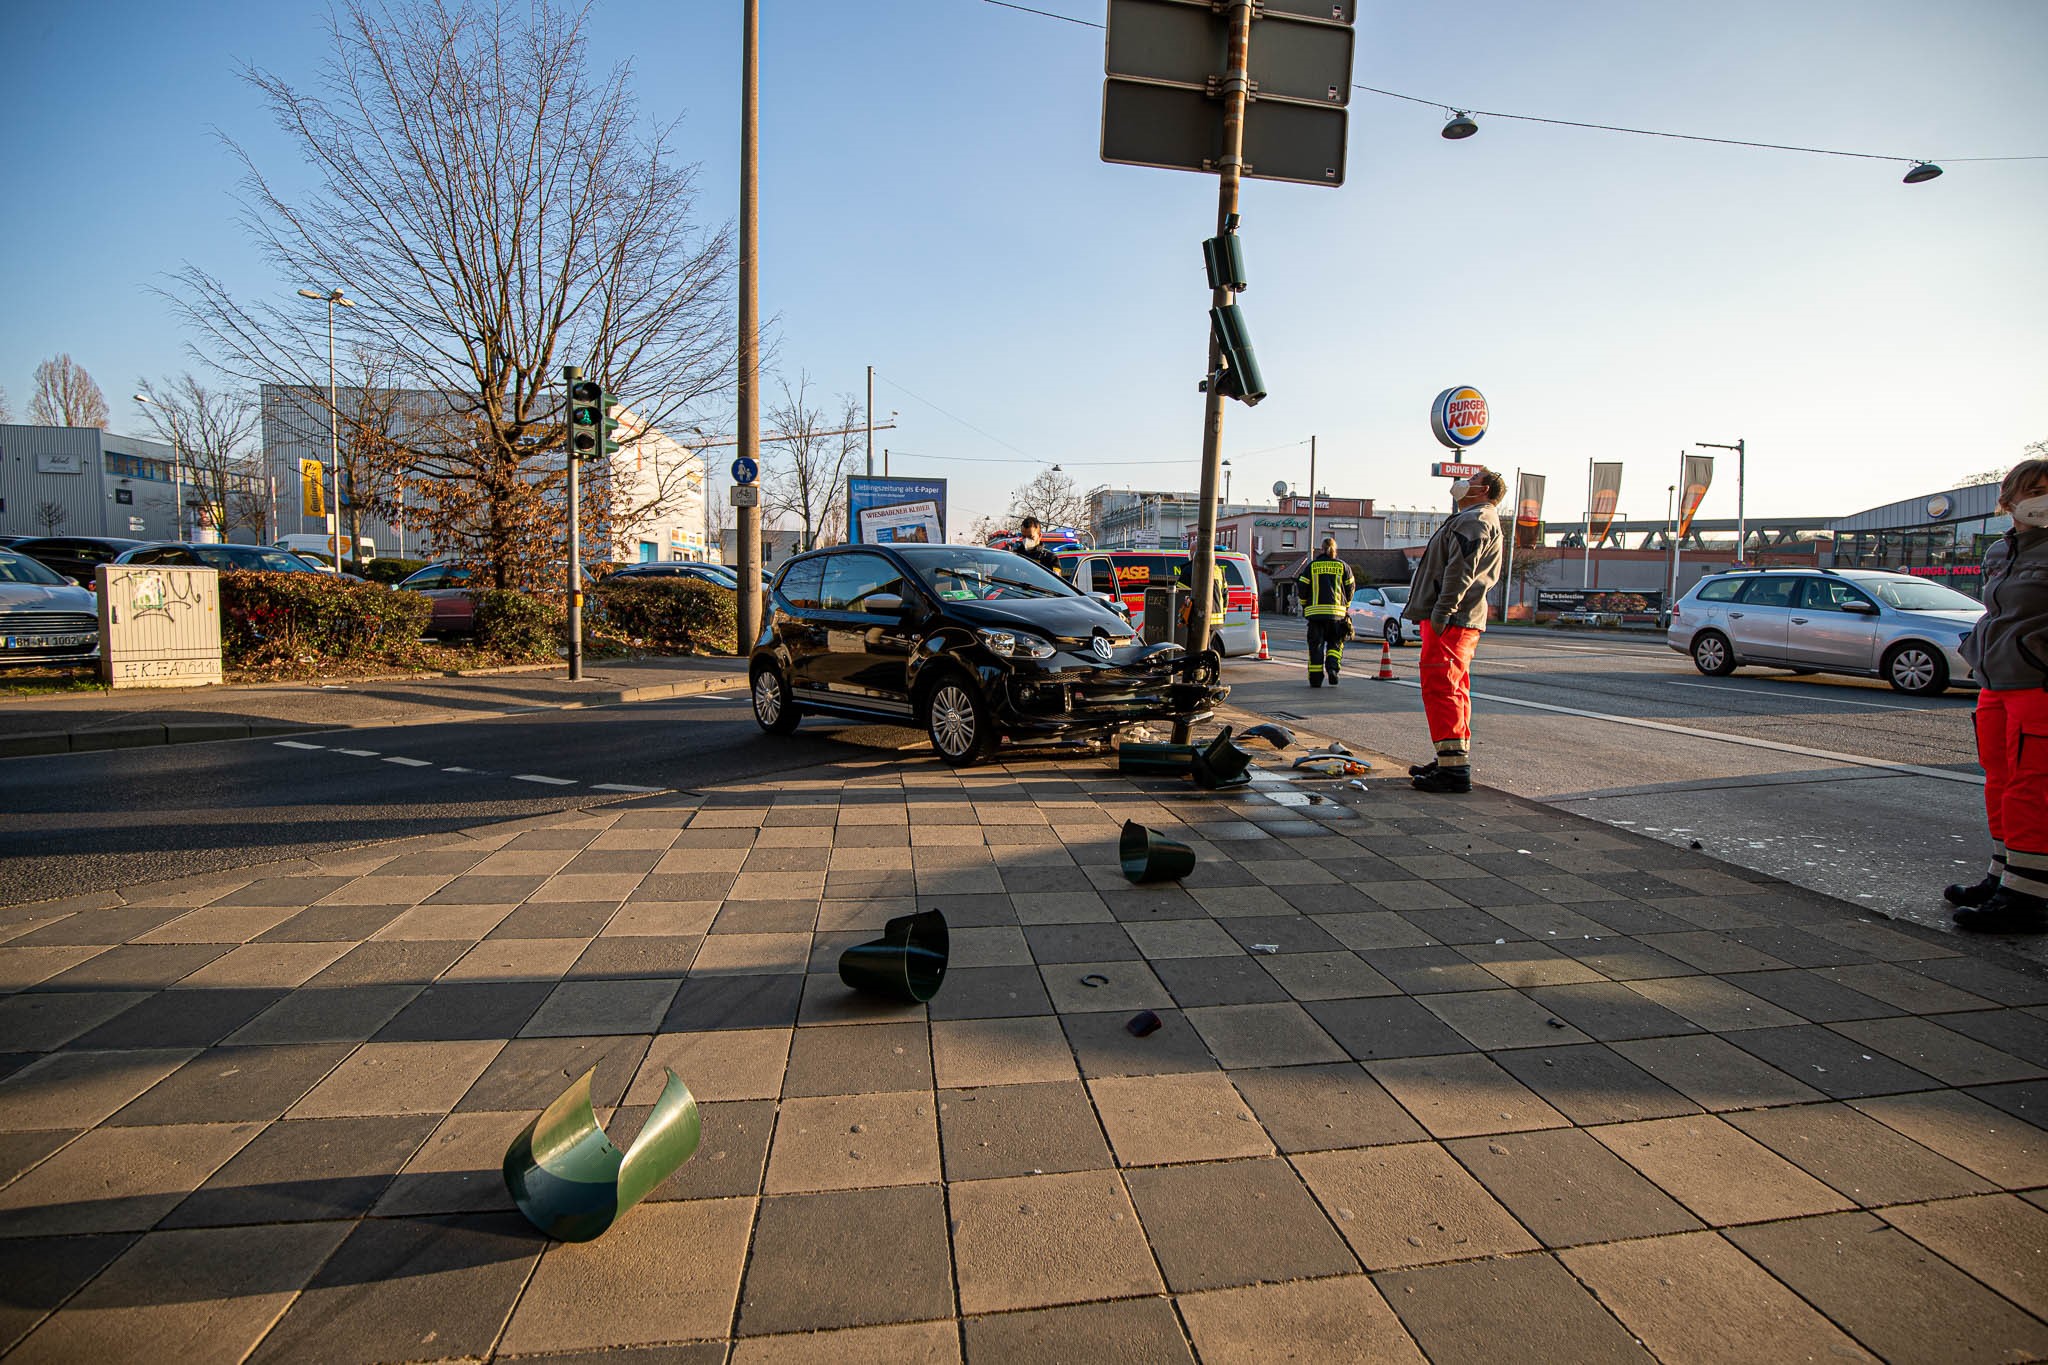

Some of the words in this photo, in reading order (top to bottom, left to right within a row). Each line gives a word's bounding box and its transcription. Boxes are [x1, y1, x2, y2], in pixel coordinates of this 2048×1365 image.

[1449, 400, 1485, 414] BURGER
[1449, 411, 1486, 429] KING
[1445, 464, 1470, 474] DRIVE
[854, 483, 904, 493] Lieblingszeitung
[914, 486, 939, 494] E-Paper
[866, 507, 908, 519] WIESBADENER
[1119, 565, 1150, 580] ASB
[1312, 567, 1342, 575] WIESBADEN
[1952, 565, 1981, 575] KING
[1540, 593, 1558, 601] King's
